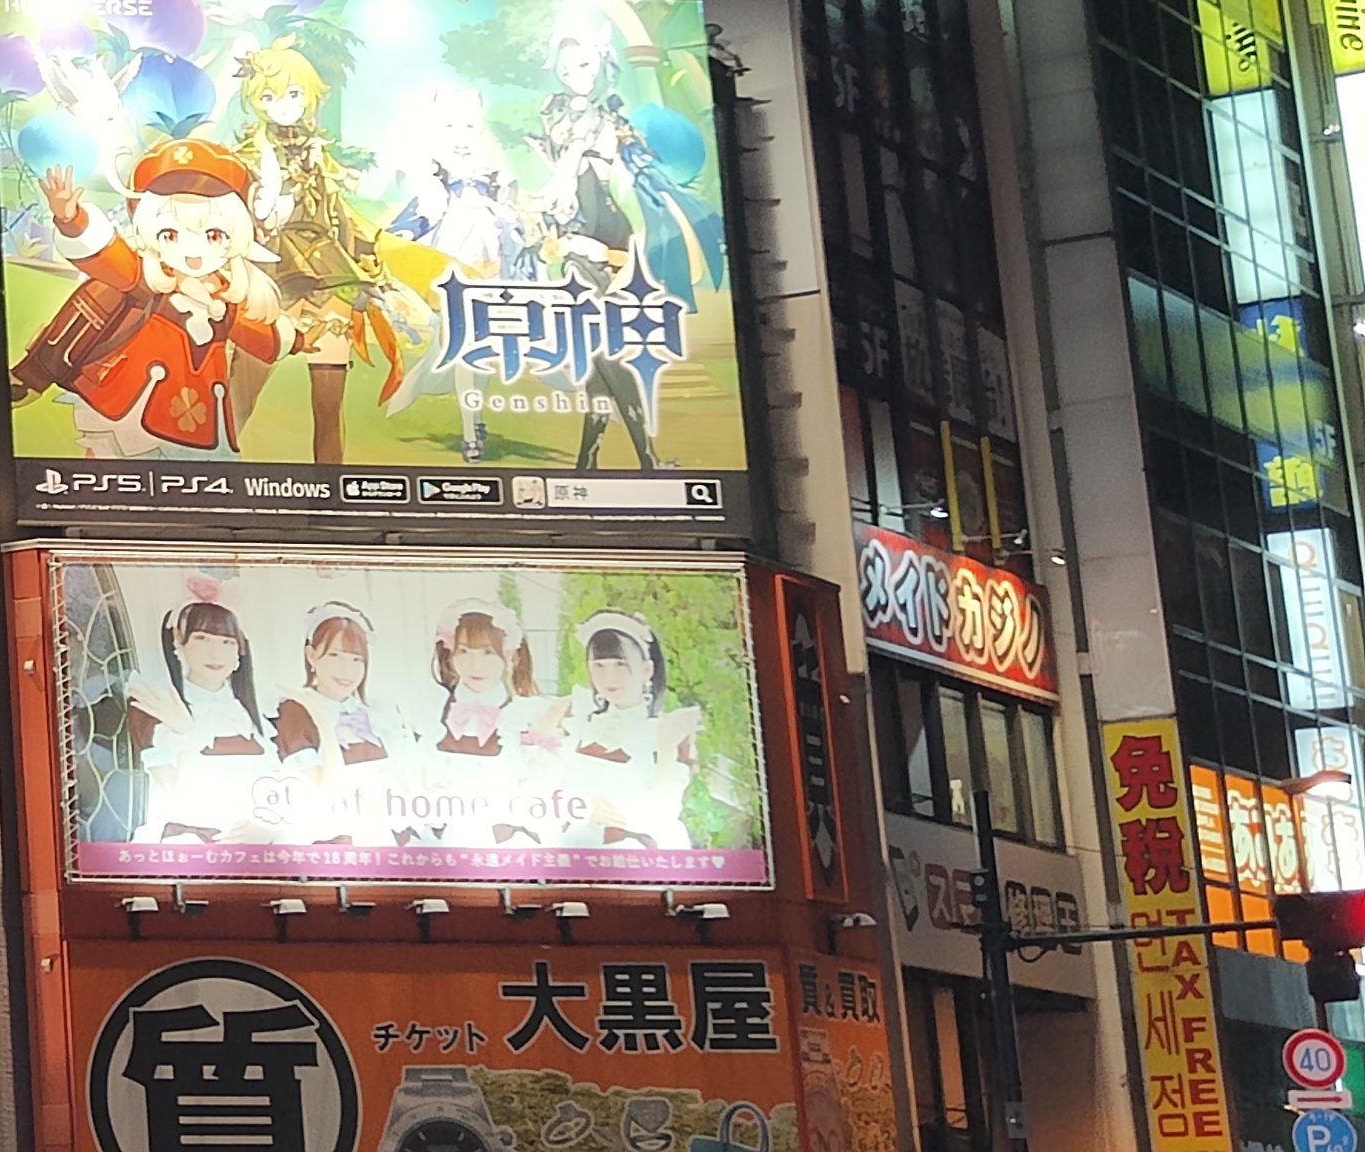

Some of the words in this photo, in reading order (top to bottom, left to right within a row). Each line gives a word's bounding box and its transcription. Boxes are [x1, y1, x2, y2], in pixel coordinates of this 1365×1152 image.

[435, 237, 689, 436] 原神
[463, 389, 614, 415] Genshin
[244, 477, 331, 499] Windows
[554, 484, 589, 501] 原神
[864, 539, 1042, 676] メイドカジノ
[1109, 733, 1191, 896] 免税
[924, 862, 1083, 956] スマ修理王
[1165, 907, 1204, 1001] TAX
[372, 1022, 488, 1054] チケット
[501, 959, 781, 1055] 大黒屋
[122, 999, 321, 1152] 質
[1180, 1016, 1224, 1138] FREE
[1299, 1047, 1331, 1072] 40
[1307, 1125, 1331, 1152] P
